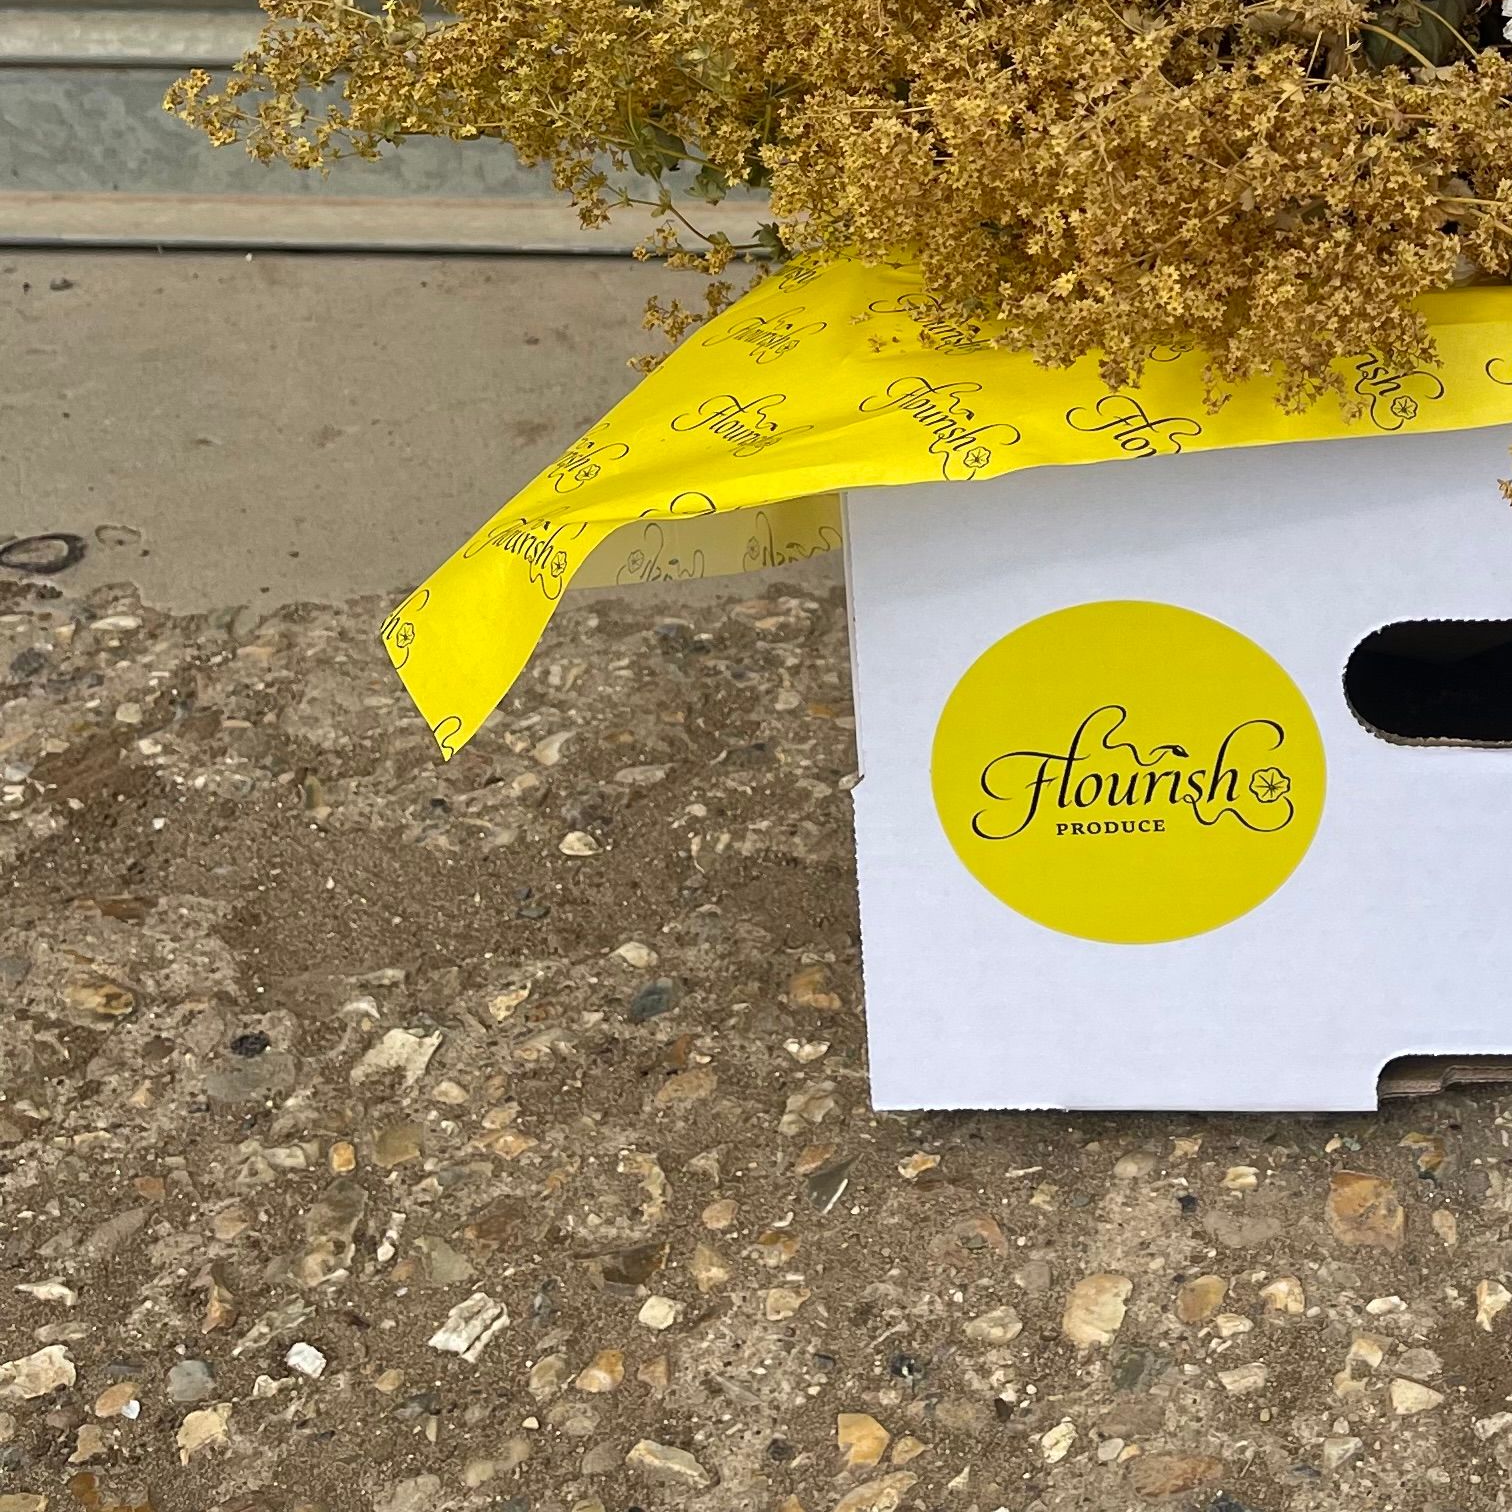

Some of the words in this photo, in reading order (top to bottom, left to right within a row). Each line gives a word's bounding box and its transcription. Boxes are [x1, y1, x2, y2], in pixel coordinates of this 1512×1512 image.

[858, 376, 1021, 481] Flourish
[971, 704, 1294, 840] Flourish
[1056, 819, 1166, 836] PRODUCE
